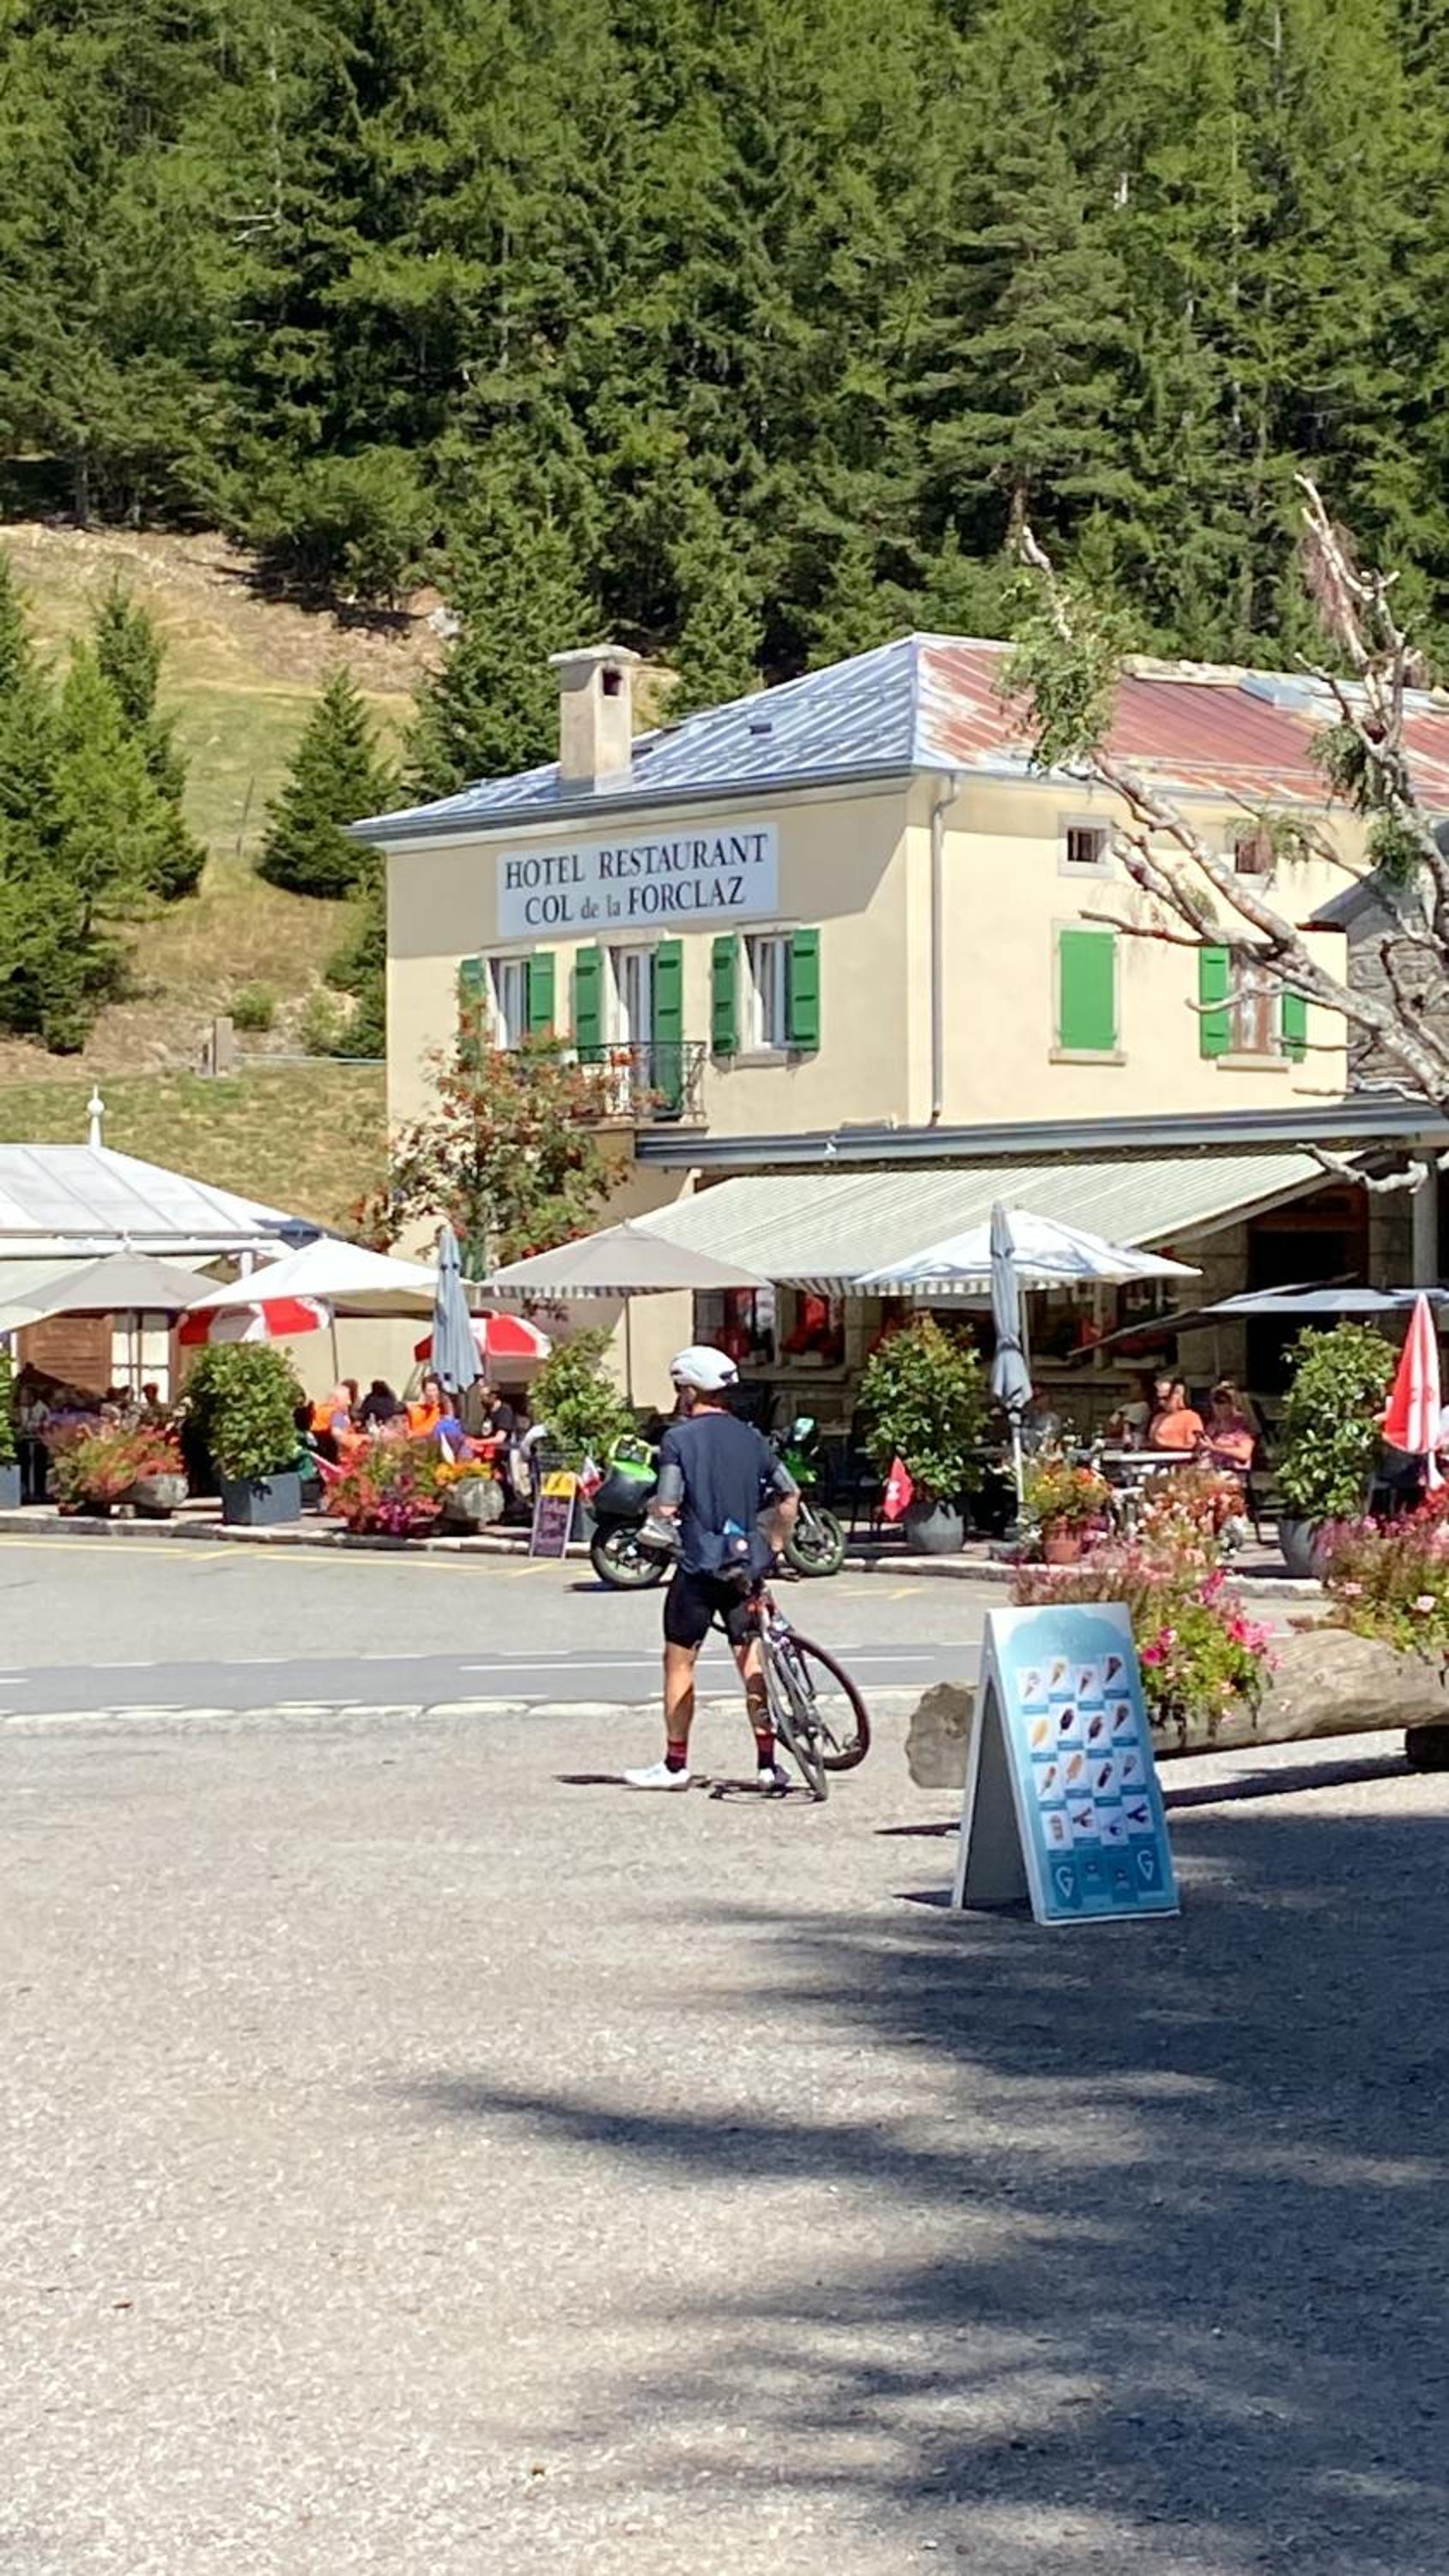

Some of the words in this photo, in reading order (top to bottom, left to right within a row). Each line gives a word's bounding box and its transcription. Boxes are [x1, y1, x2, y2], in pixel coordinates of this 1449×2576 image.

[505, 854, 585, 890] HOTEL
[597, 833, 768, 880] RESTAURANT
[524, 894, 575, 925] COL
[580, 896, 599, 919] de
[606, 894, 621, 917] la
[627, 876, 746, 915] FORCLAZ
